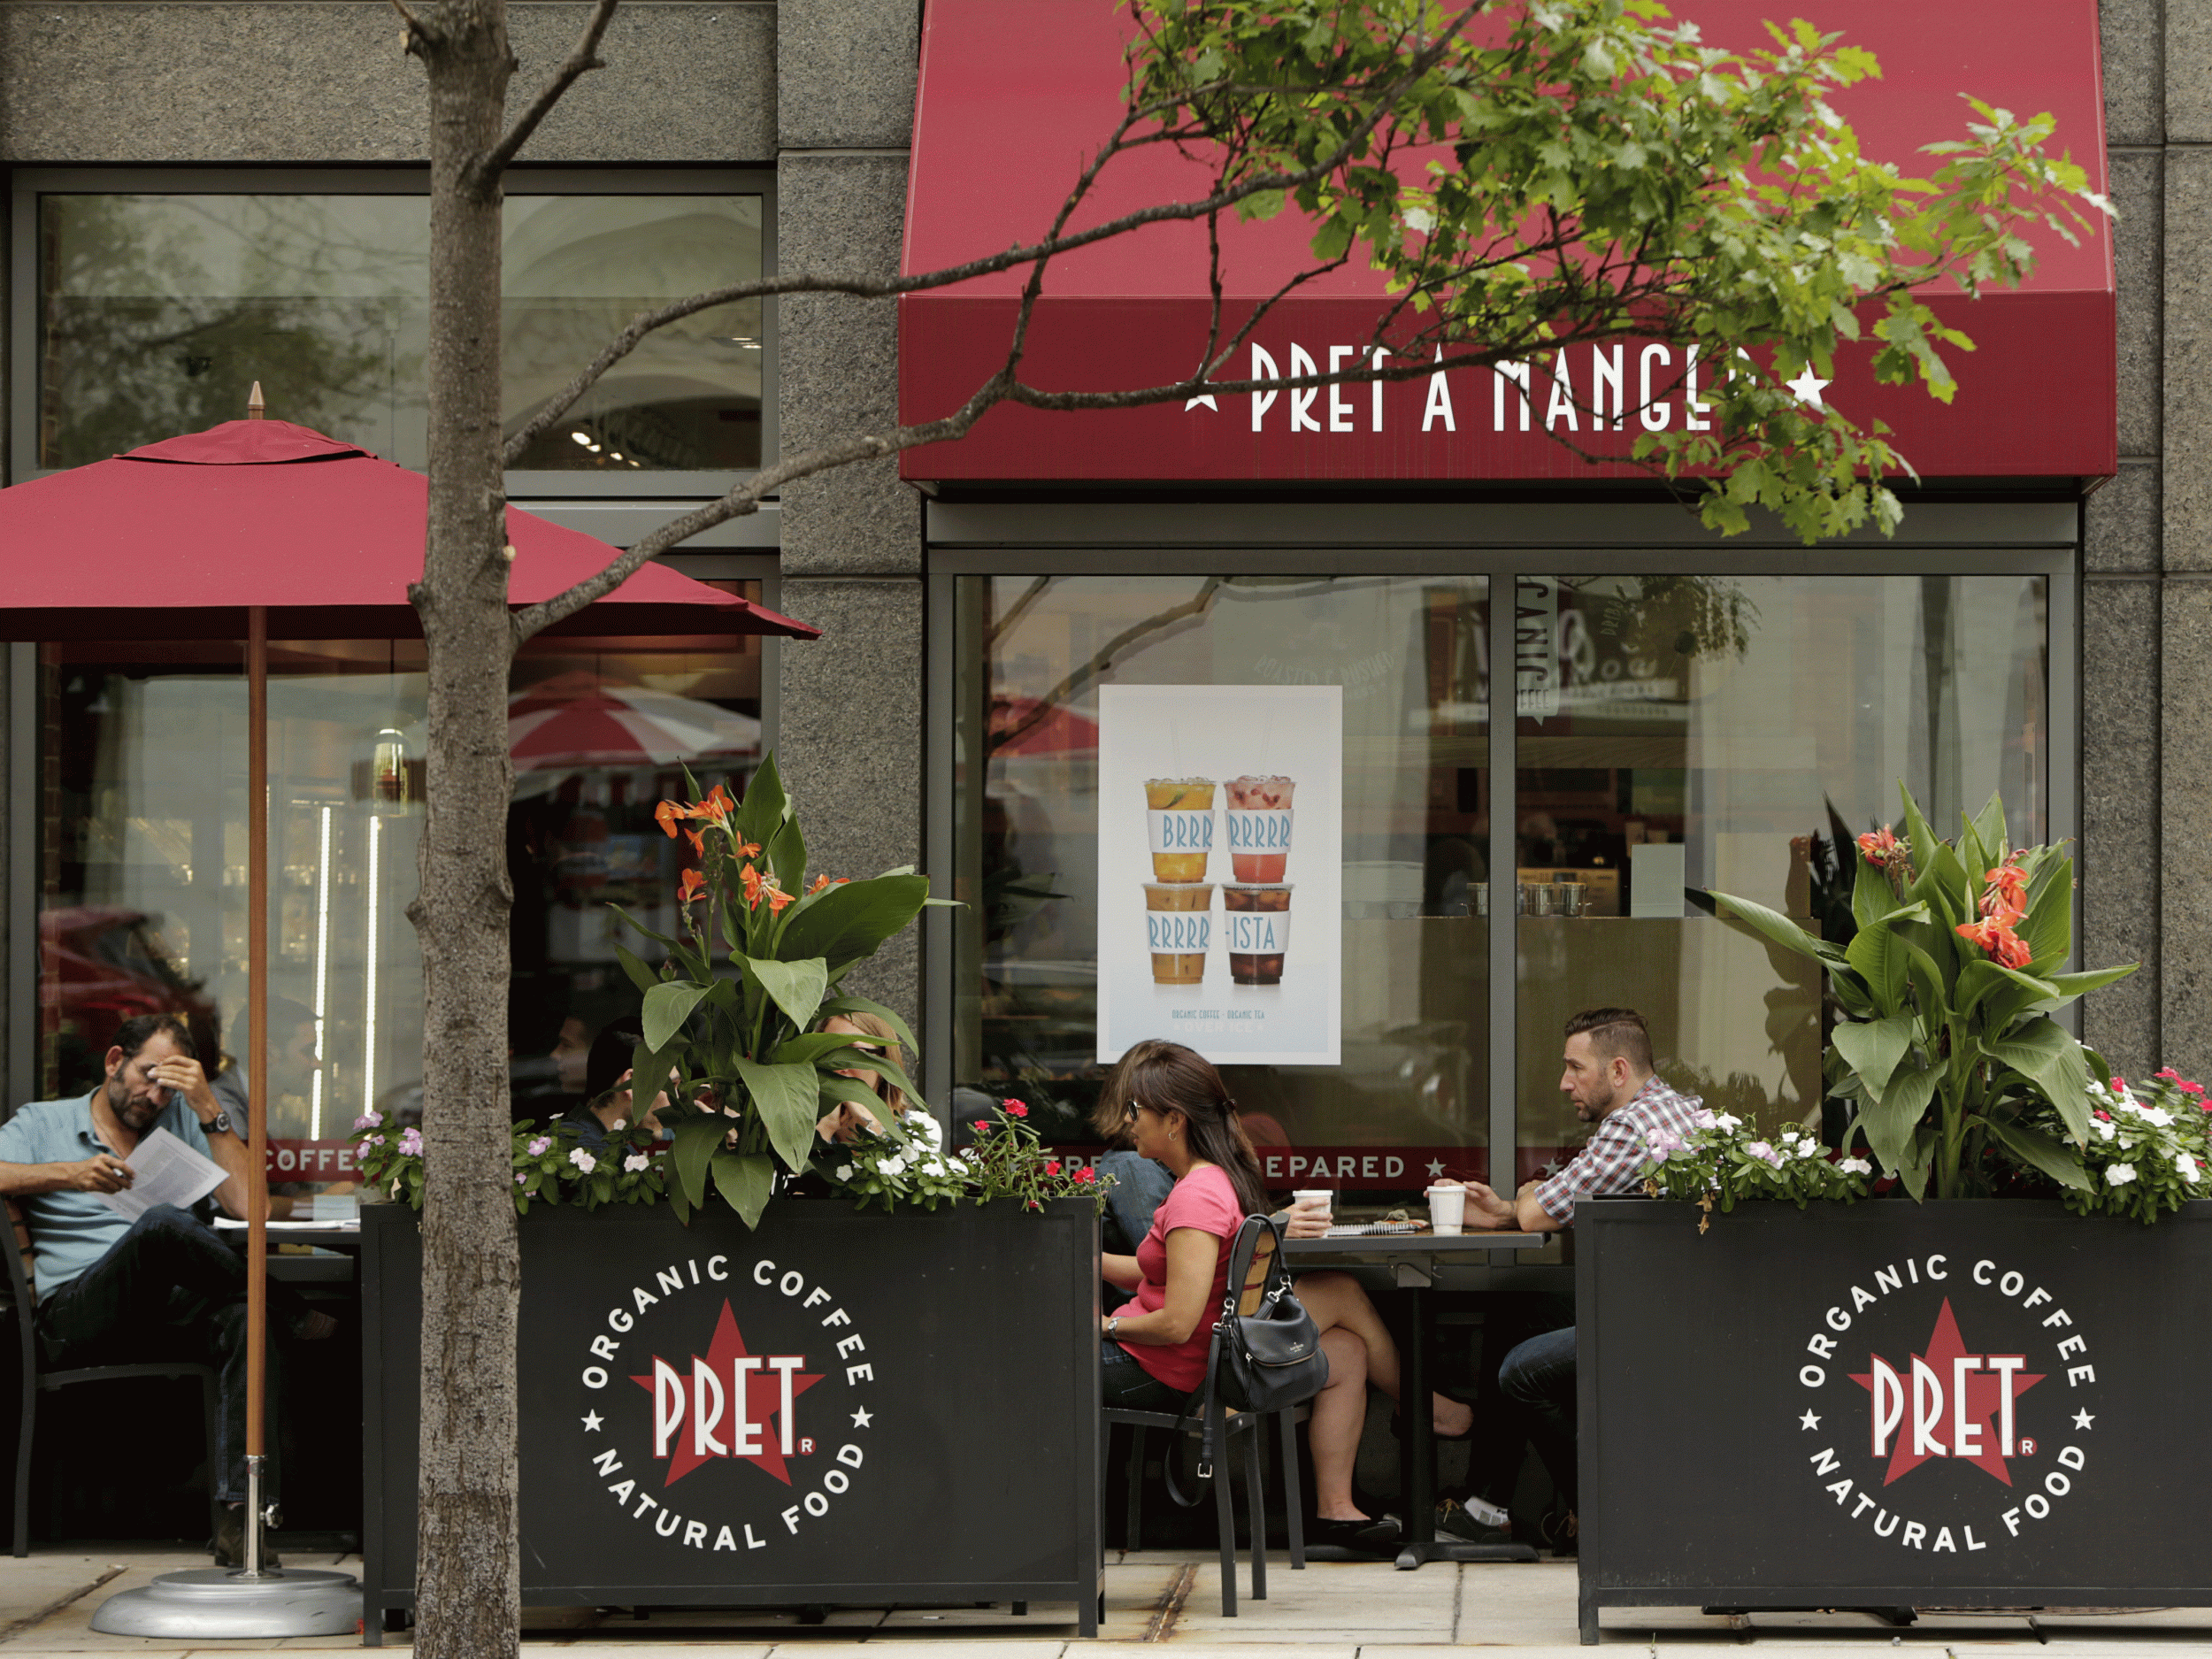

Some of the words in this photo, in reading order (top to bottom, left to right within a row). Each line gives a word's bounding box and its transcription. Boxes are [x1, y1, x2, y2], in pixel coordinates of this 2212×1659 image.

[1251, 342, 1393, 433] PRET
[1421, 342, 1456, 433] A
[1163, 814, 1213, 848] BRRR
[1228, 814, 1291, 848] RRRRR
[1148, 916, 1210, 949] RRRRR
[1171, 1009, 1197, 1019] ORGANIC
[1199, 1009, 1220, 1019] COFFEE
[1226, 1009, 1252, 1019] ORGANIC
[1254, 1009, 1265, 1019] TEA
[1266, 1156, 1403, 1178] EPARED
[581, 1255, 728, 1389] ORGANIC
[754, 1260, 874, 1386] COFFEE
[1799, 1254, 1948, 1388] ORGANIC
[1972, 1259, 2096, 1387] COFFEE
[656, 1356, 803, 1457] PRET
[1872, 1356, 2024, 1457] PRET
[593, 1448, 766, 1552] NATURAL
[780, 1443, 864, 1535] FOOD
[1809, 1447, 1987, 1553] NATURAL
[2001, 1445, 2085, 1538] FOOD
